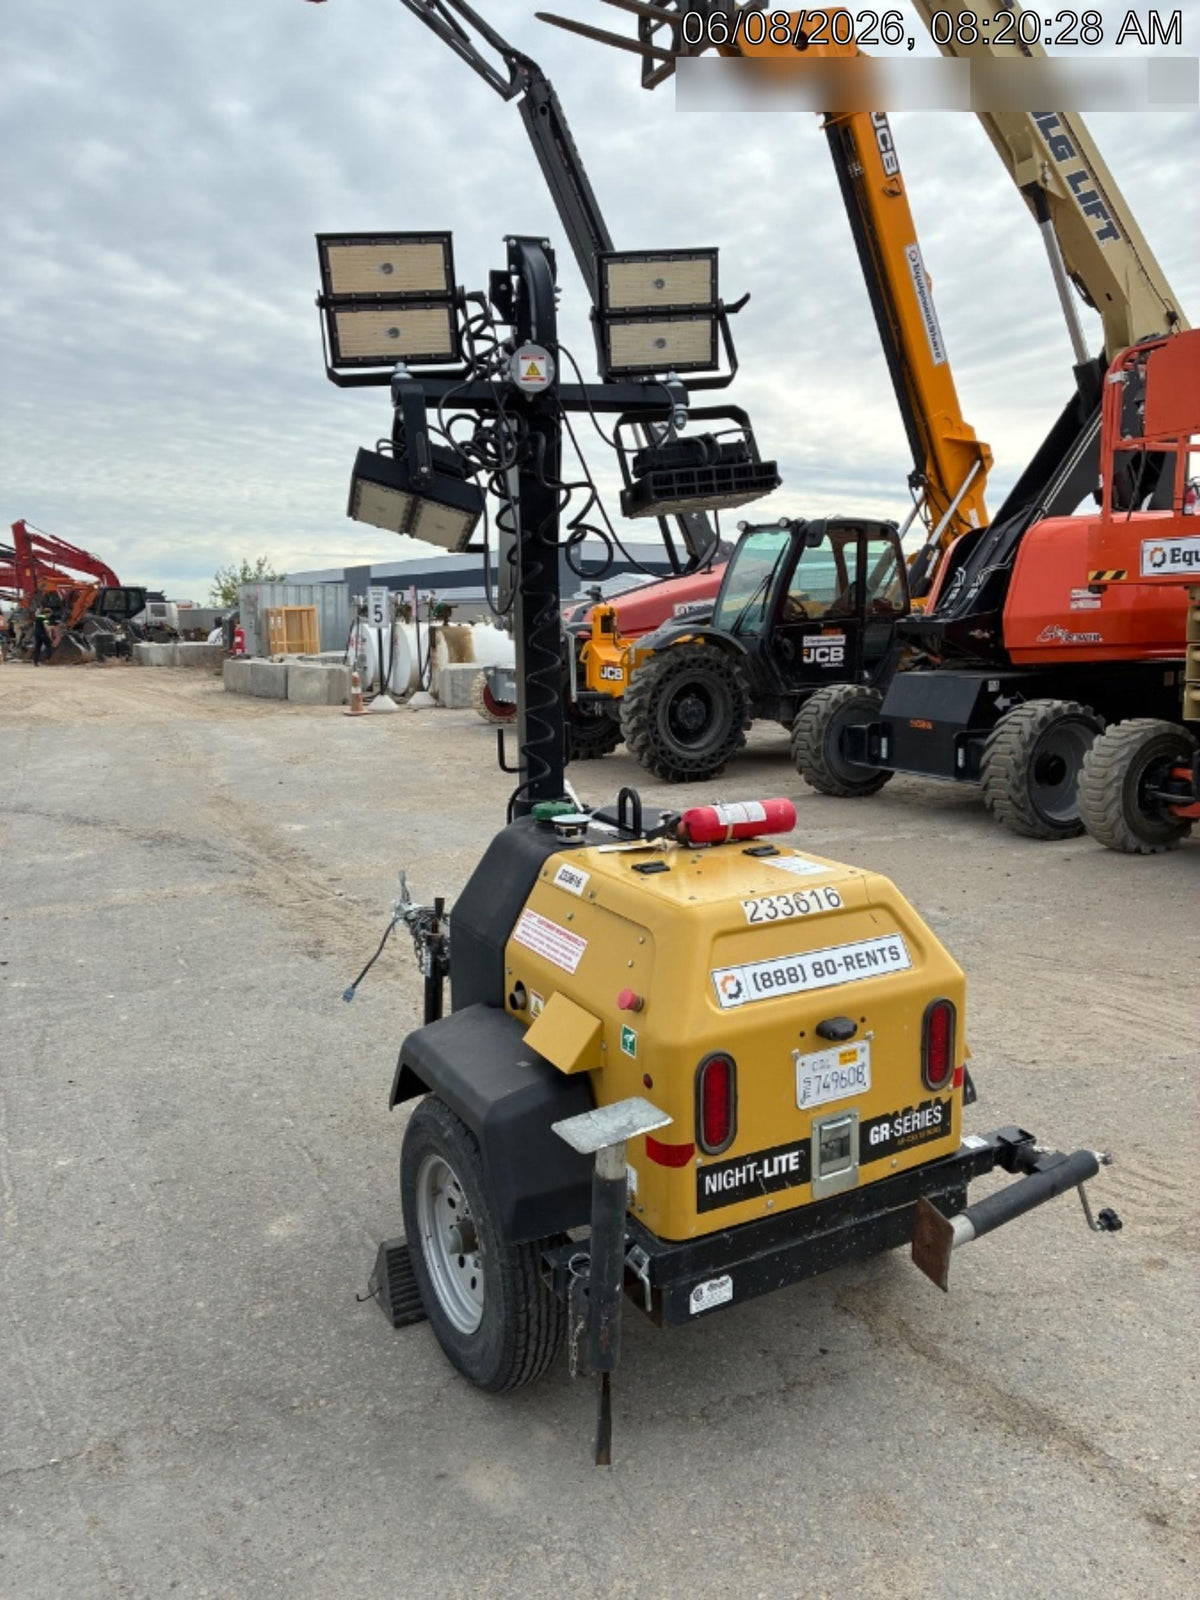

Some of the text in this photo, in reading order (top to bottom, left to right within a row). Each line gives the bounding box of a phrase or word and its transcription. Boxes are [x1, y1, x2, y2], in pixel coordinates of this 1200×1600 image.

[869, 112, 900, 176] JCB
[1067, 169, 1121, 243] LIFT
[374, 604, 383, 623] 5
[600, 666, 623, 680] JCB
[803, 646, 844, 663] JCB
[744, 887, 842, 923] 233616
[752, 945, 901, 992] (888) 80-RENTS
[814, 1064, 865, 1097] 749608
[868, 1105, 942, 1146] GR-SERIES
[705, 1151, 799, 1195] NIGHT-LITE
